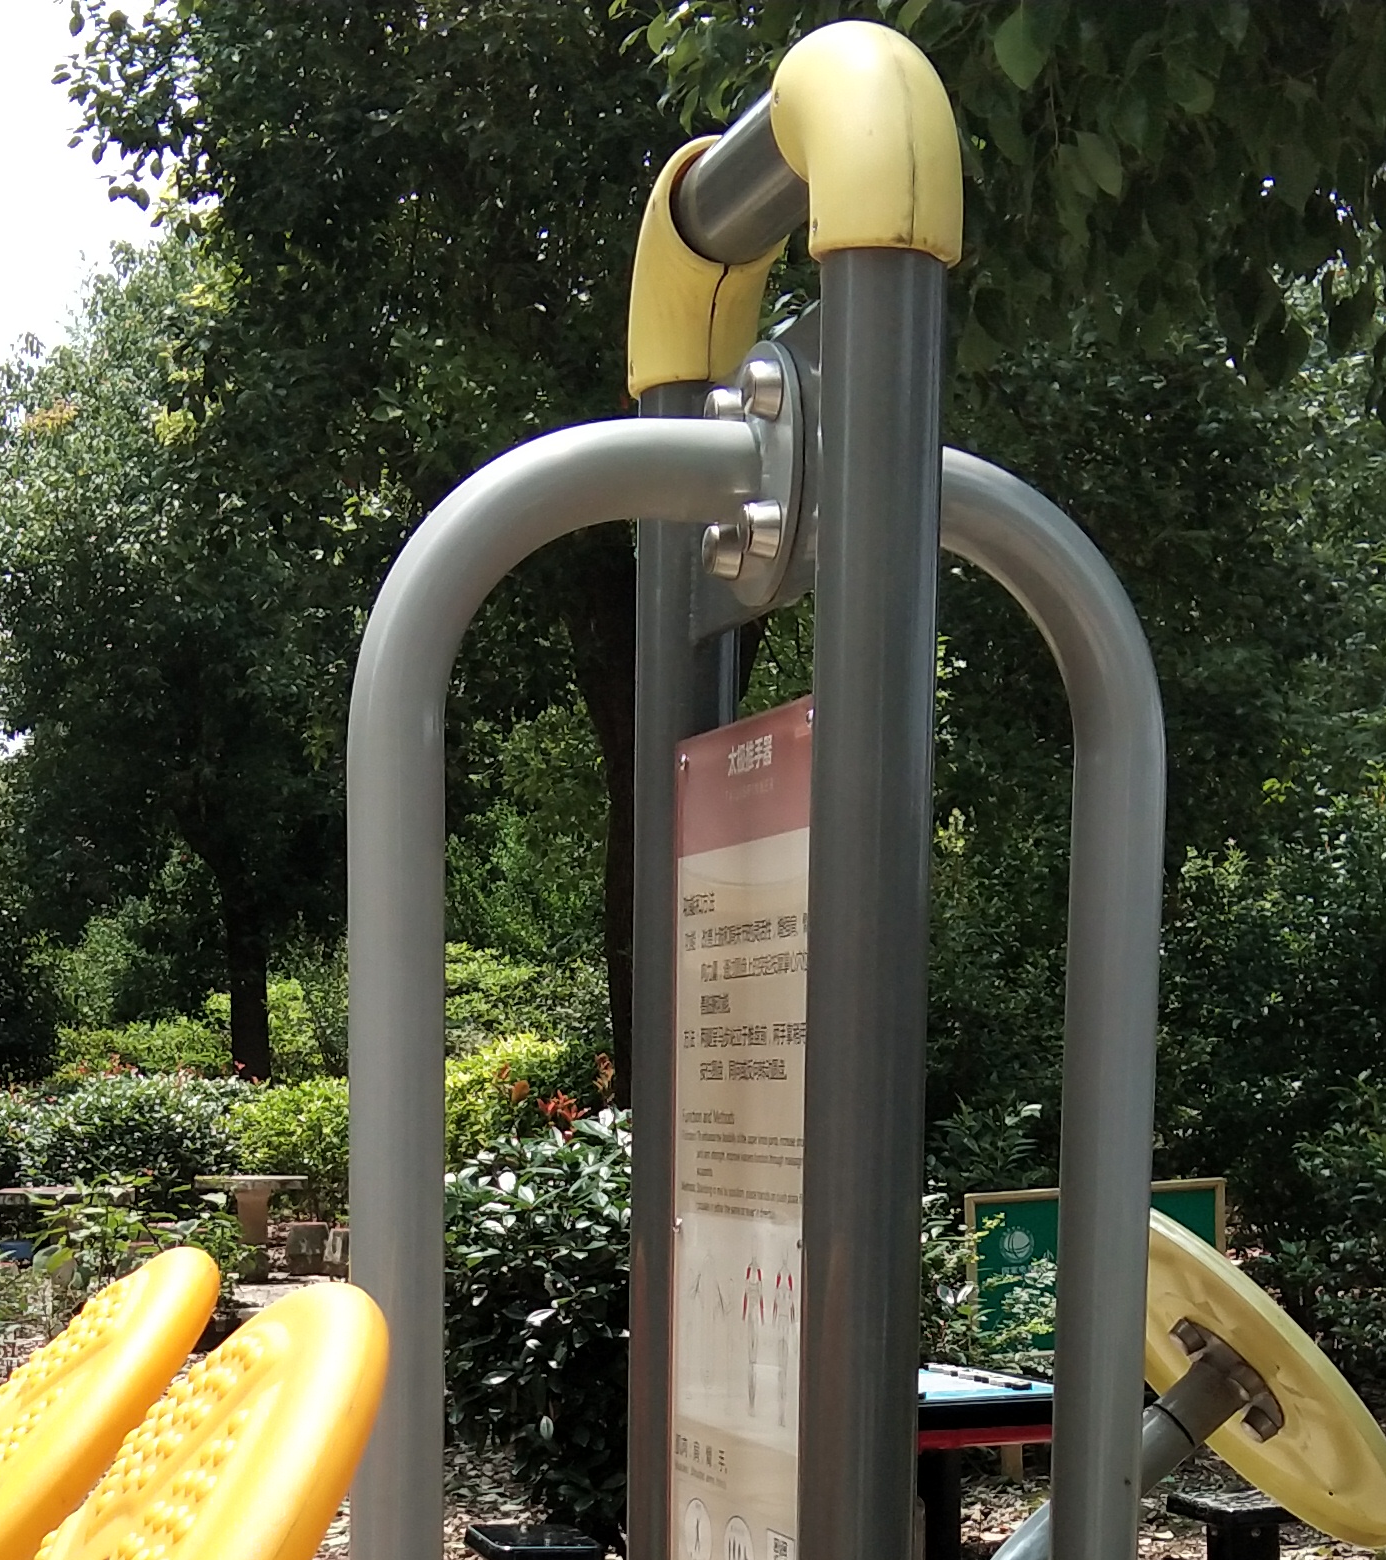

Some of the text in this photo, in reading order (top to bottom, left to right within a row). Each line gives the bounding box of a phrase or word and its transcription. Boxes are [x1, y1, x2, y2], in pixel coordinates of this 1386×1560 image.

[728, 734, 773, 777] 太极推手器
